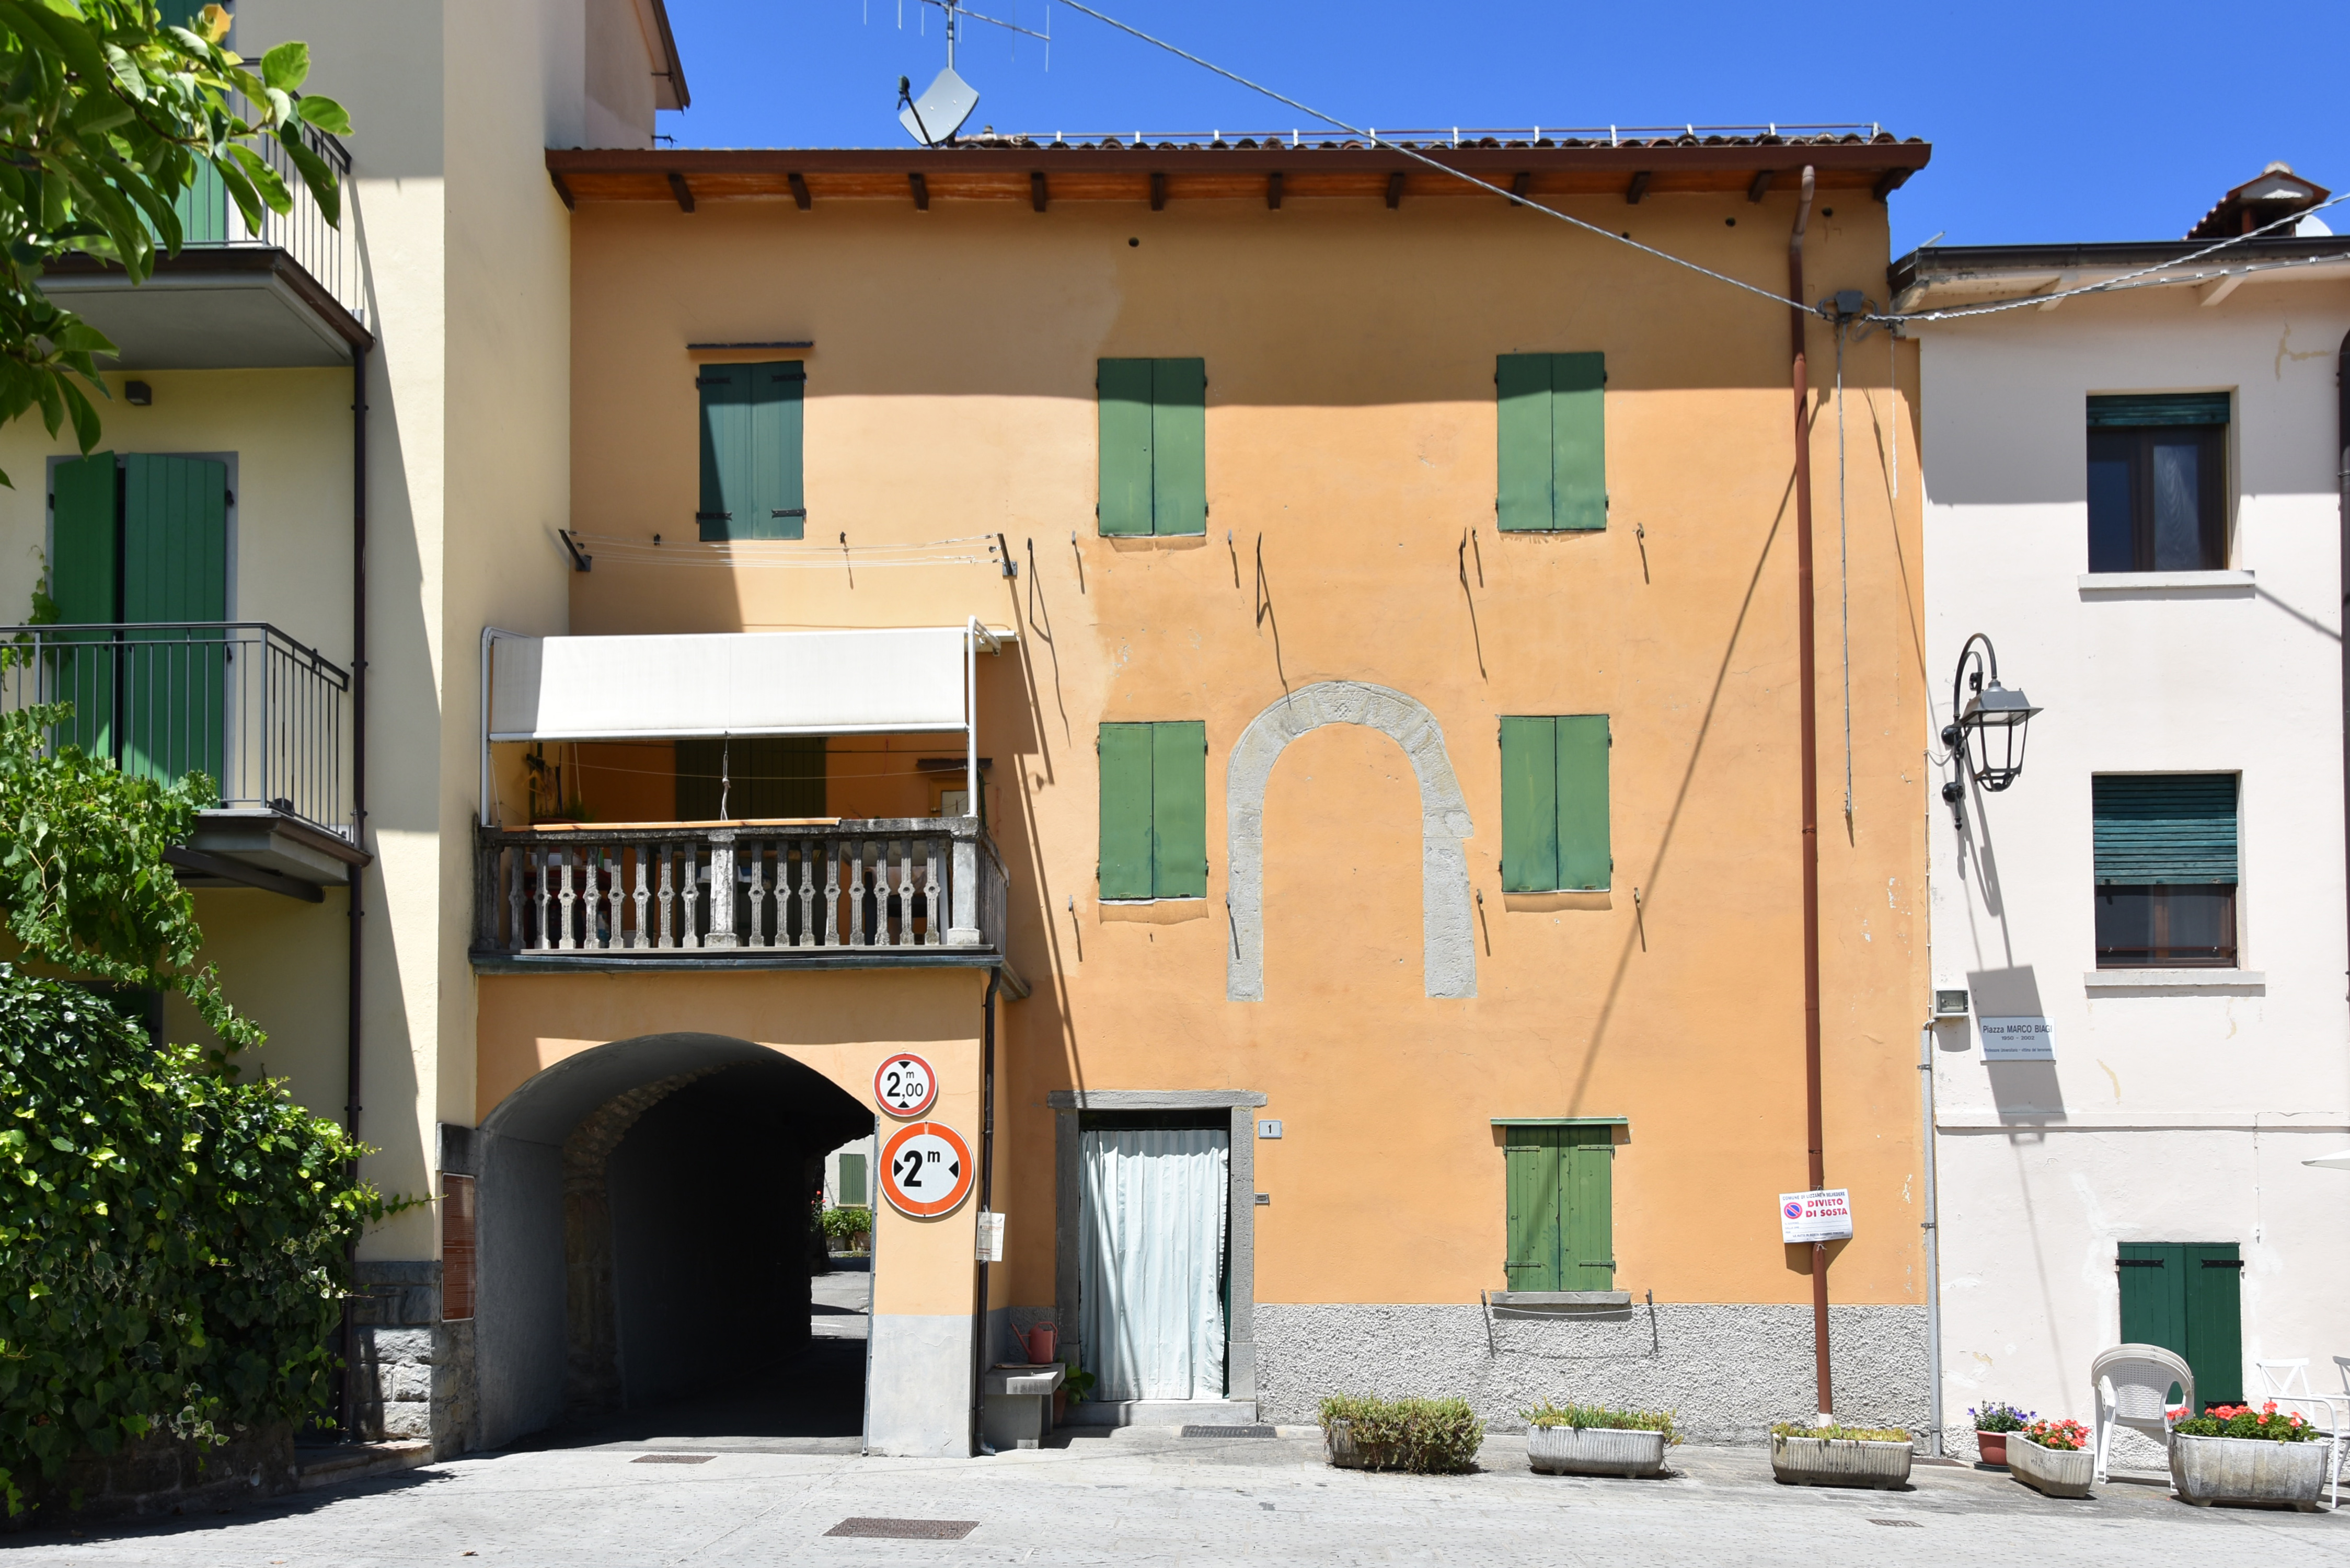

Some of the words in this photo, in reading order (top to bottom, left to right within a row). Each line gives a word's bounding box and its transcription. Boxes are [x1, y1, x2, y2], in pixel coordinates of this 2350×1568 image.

[2007, 1025, 2032, 1033] MARCO
[1268, 1124, 1272, 1134] 1
[903, 1150, 923, 1187] 2
[927, 1151, 940, 1162] m
[1807, 1198, 1843, 1207] DIVIETO
[1820, 1208, 1848, 1217] SOSTA
